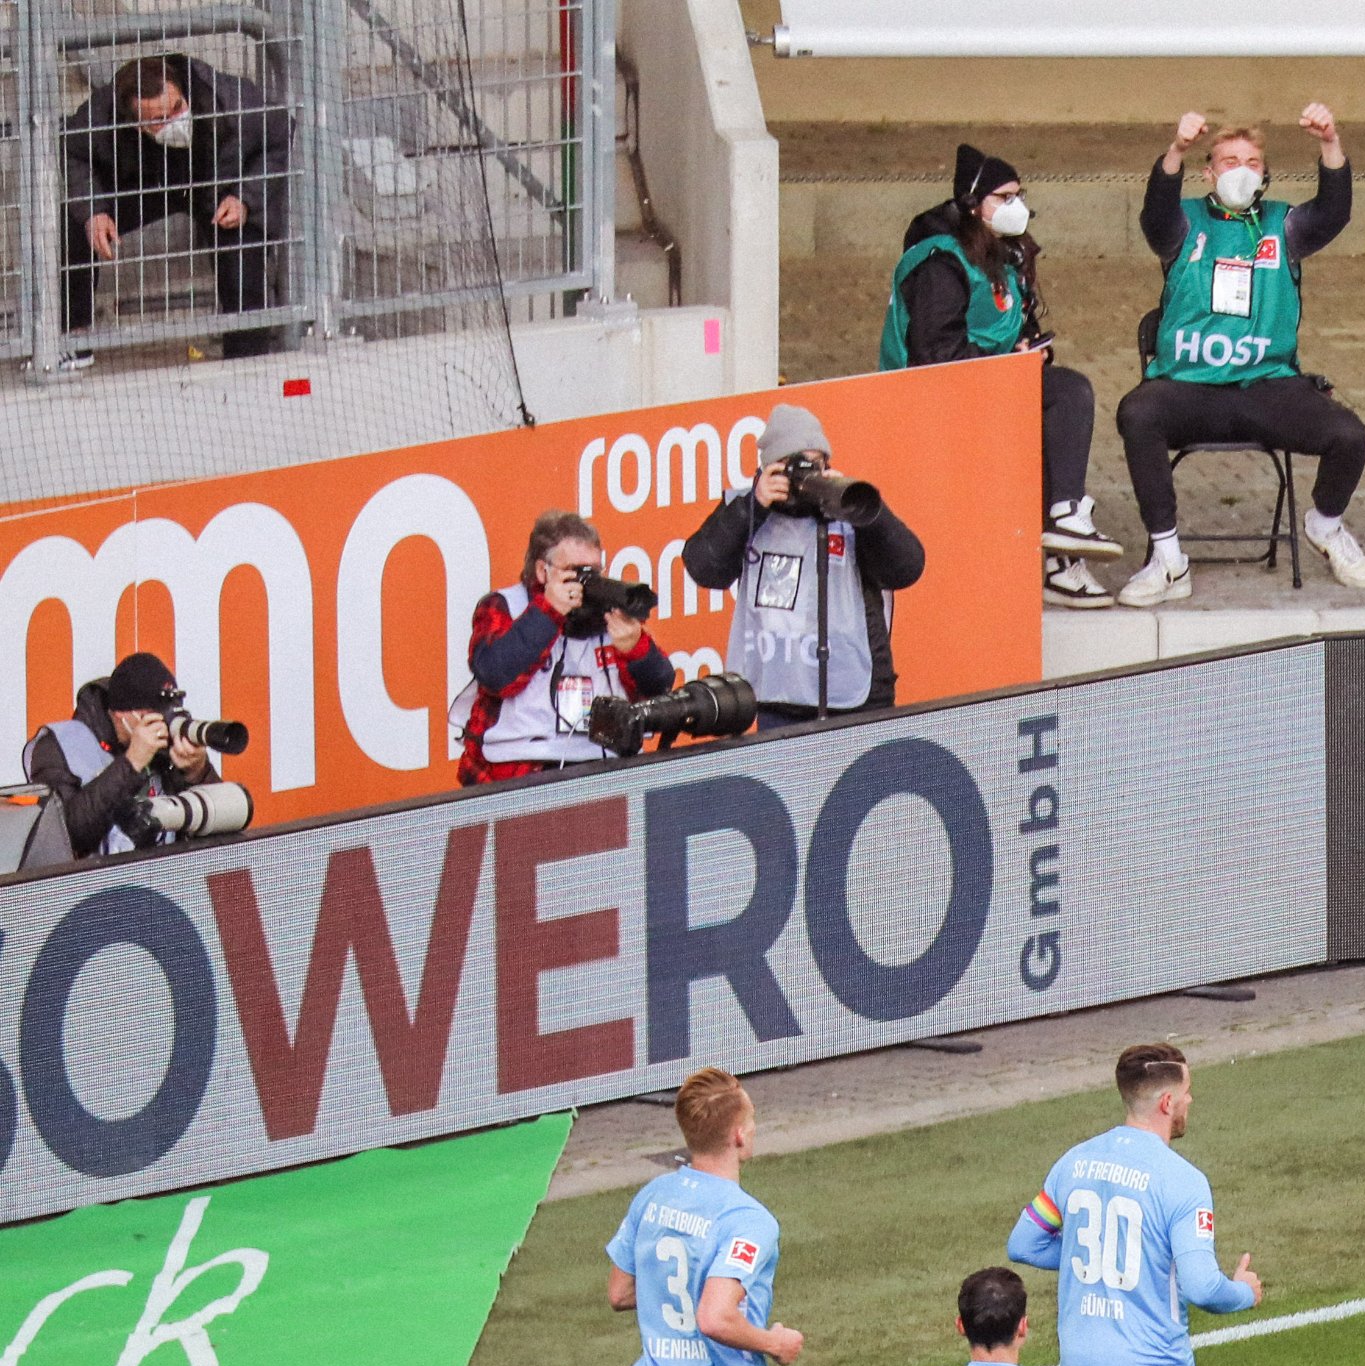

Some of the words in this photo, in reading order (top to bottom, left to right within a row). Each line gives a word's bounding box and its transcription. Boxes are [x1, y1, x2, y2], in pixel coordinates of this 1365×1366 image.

[1174, 329, 1272, 367] HOST
[0, 738, 994, 1178] OWERO
[1018, 714, 1062, 992] GmbH
[1072, 1159, 1087, 1179] SC
[1087, 1160, 1150, 1192] FREIBURG
[655, 1236, 697, 1333] 3
[1067, 1188, 1144, 1292] 30
